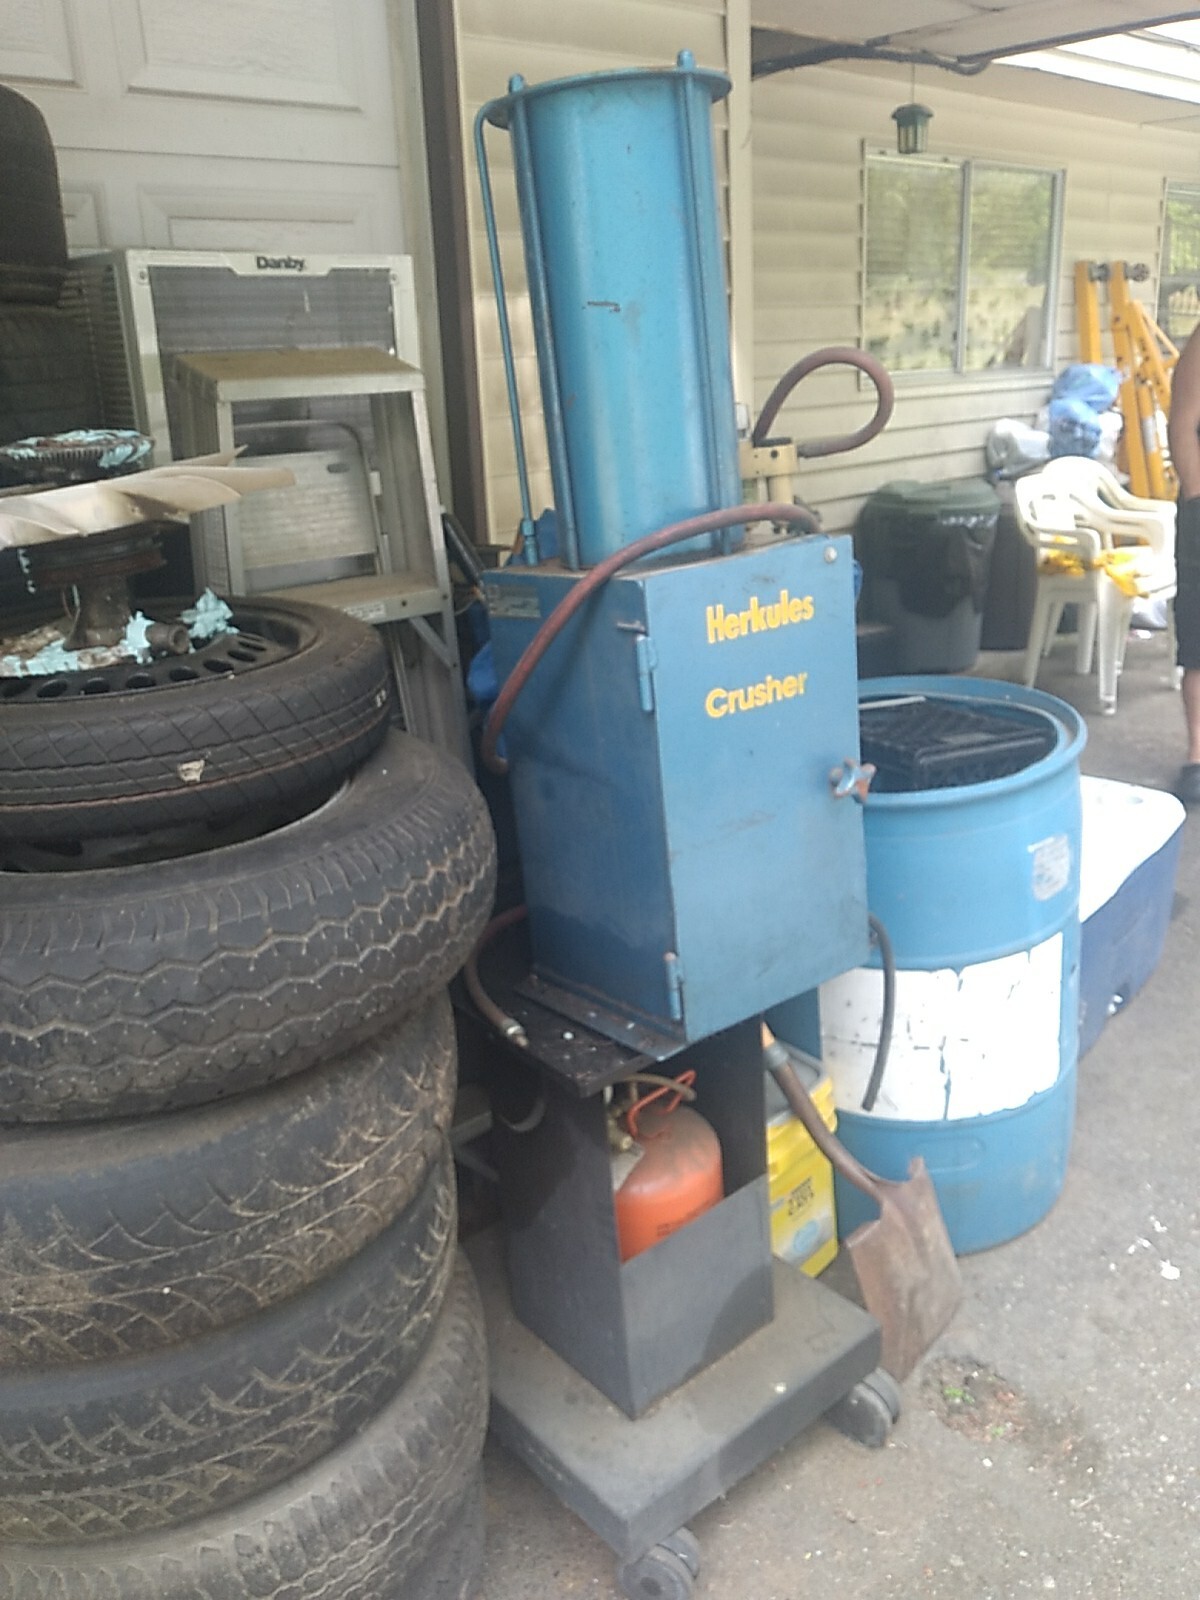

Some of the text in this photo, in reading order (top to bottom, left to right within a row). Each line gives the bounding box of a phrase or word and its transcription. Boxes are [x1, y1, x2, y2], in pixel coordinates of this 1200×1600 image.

[257, 256, 304, 272] Danby
[706, 589, 814, 643] Herkules
[705, 673, 808, 718] Crusher
